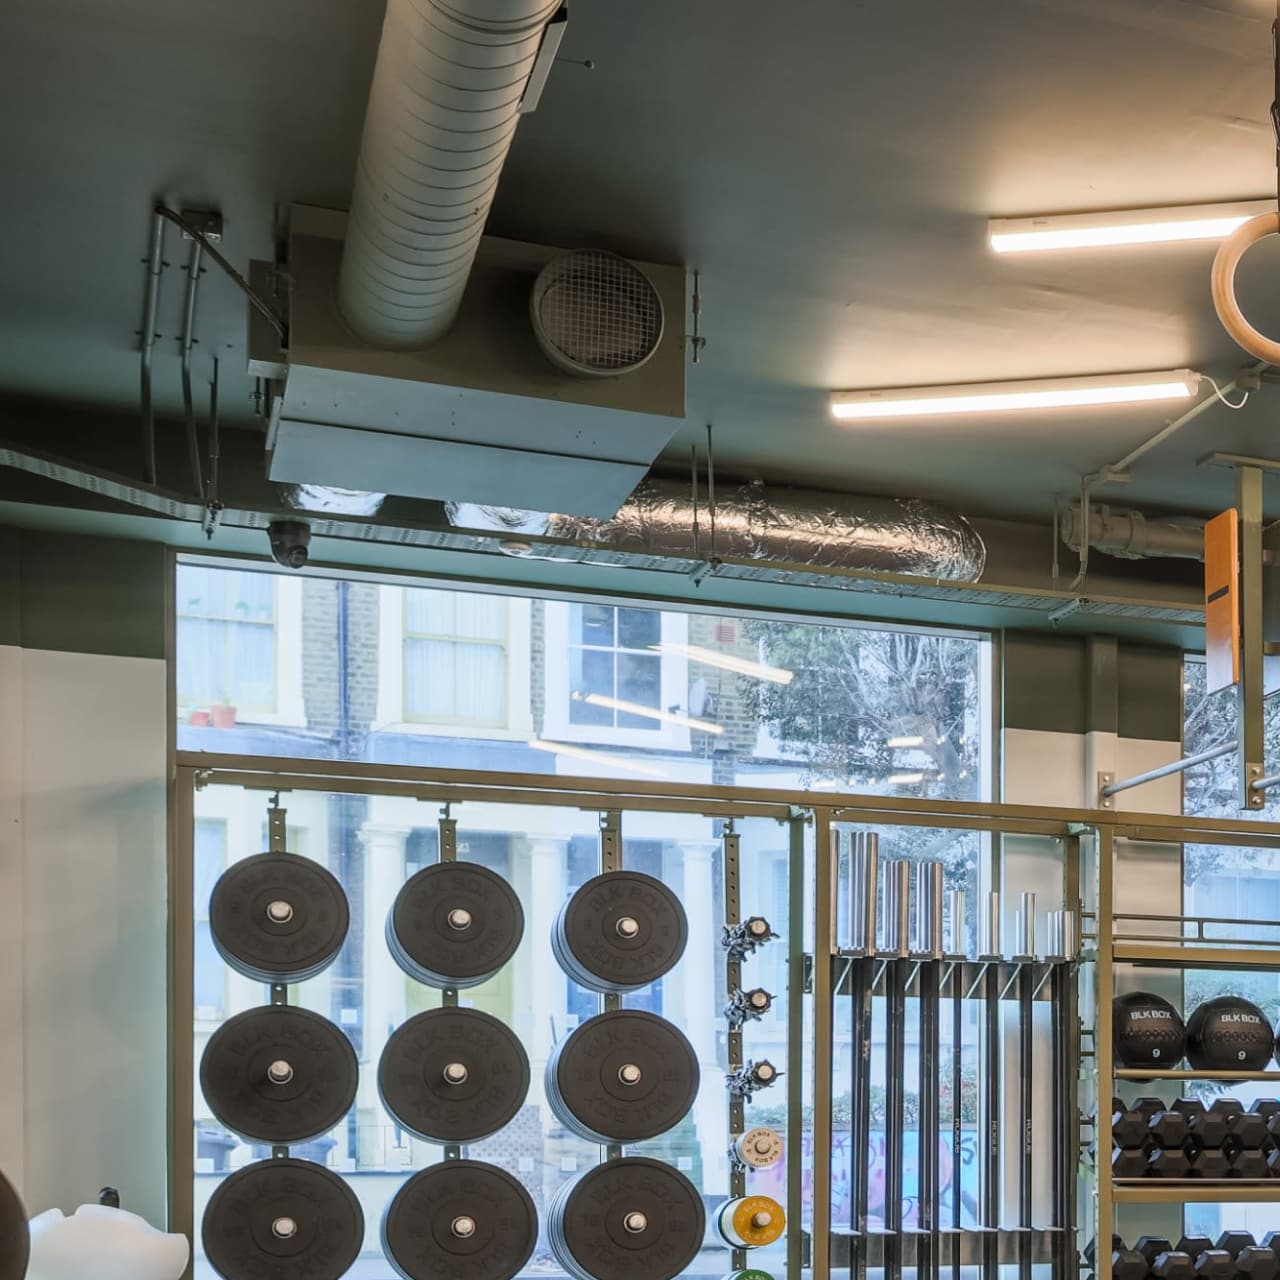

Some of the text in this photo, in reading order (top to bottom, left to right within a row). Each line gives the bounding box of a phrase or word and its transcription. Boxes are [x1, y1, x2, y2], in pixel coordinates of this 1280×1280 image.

[1130, 1010, 1172, 1020] BLK BOX
[1221, 1014, 1261, 1024] BLK BOX
[1152, 1049, 1160, 1058] 9
[1238, 1050, 1246, 1060] 9
